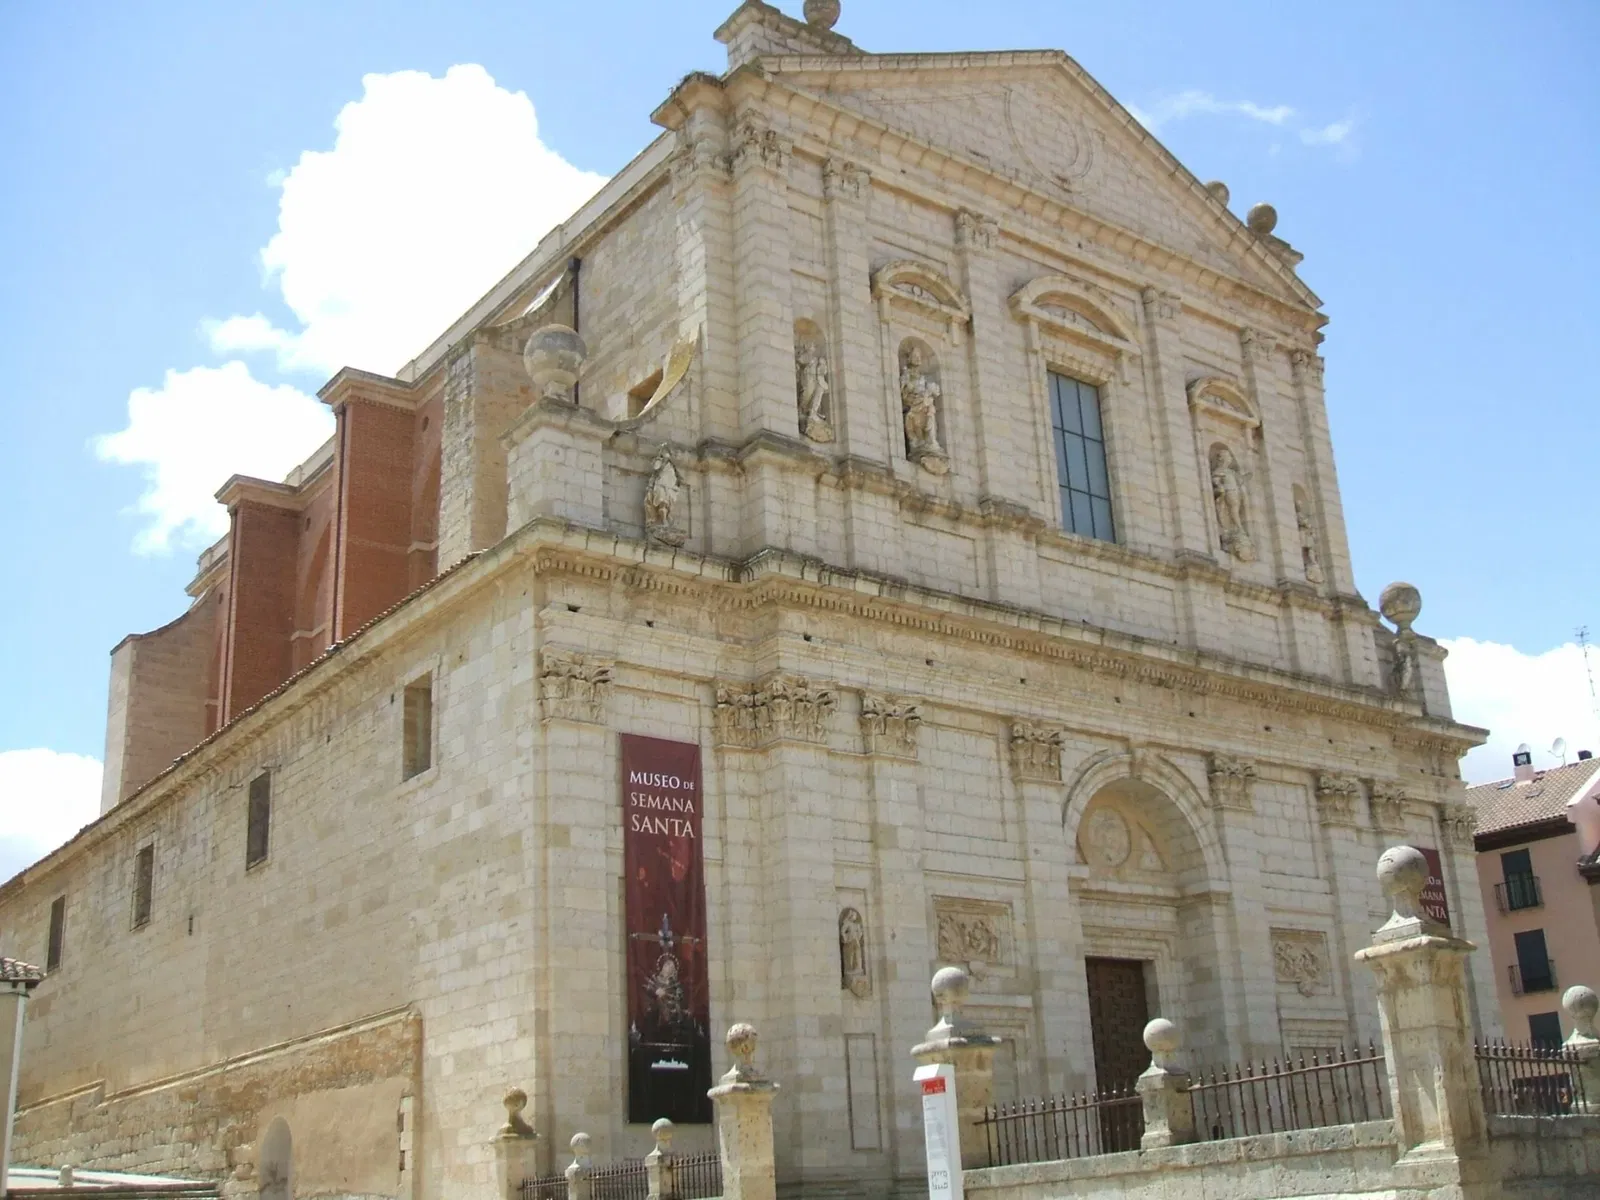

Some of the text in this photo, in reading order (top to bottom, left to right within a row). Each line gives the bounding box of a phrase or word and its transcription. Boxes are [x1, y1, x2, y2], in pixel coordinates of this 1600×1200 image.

[629, 770, 695, 790] MUSEO DE
[630, 792, 695, 813] SEMANA
[631, 813, 696, 838] SANTA
[1420, 889, 1445, 901] MANA
